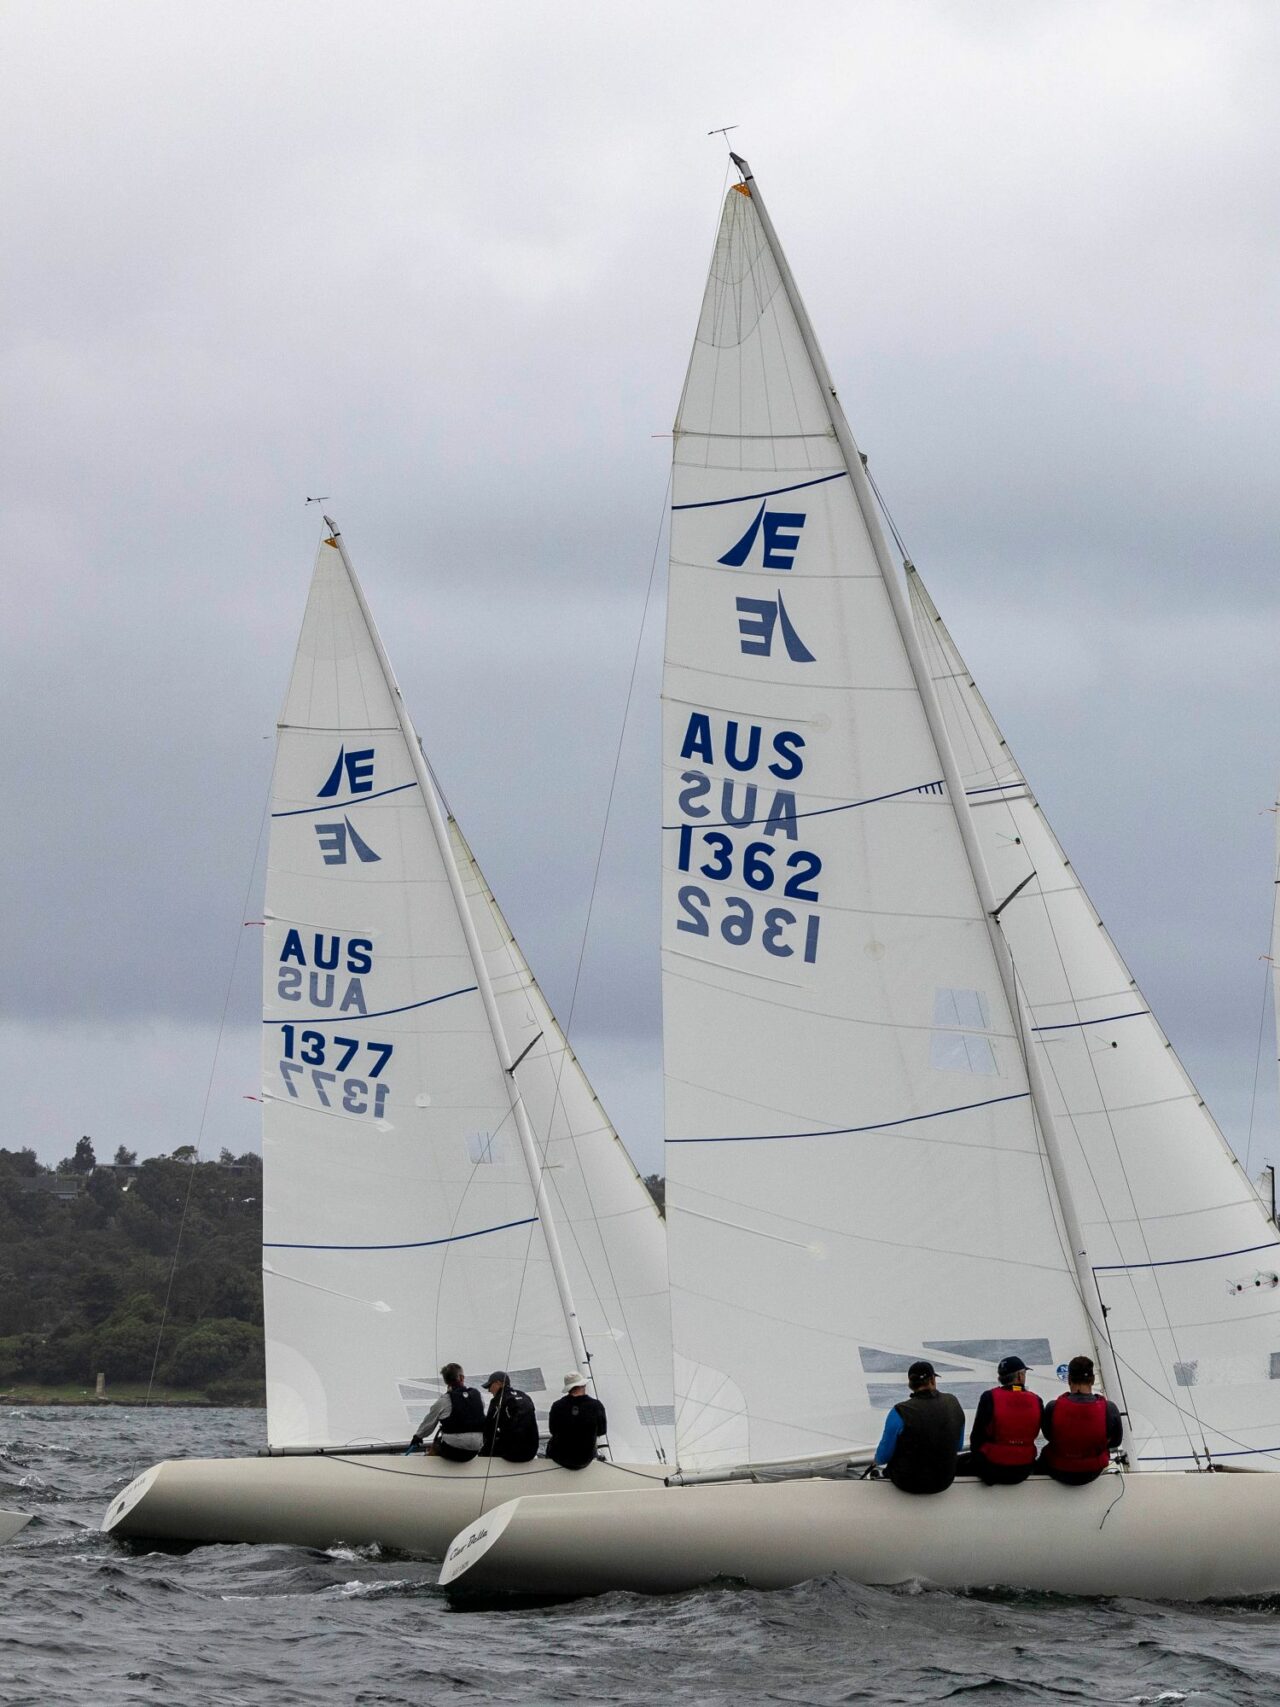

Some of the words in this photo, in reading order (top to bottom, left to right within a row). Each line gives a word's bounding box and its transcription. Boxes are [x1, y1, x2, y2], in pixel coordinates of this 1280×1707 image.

[680, 712, 806, 780] AUS
[678, 824, 823, 902] 1362
[280, 928, 373, 975] AUS
[280, 1024, 394, 1078] 1377
